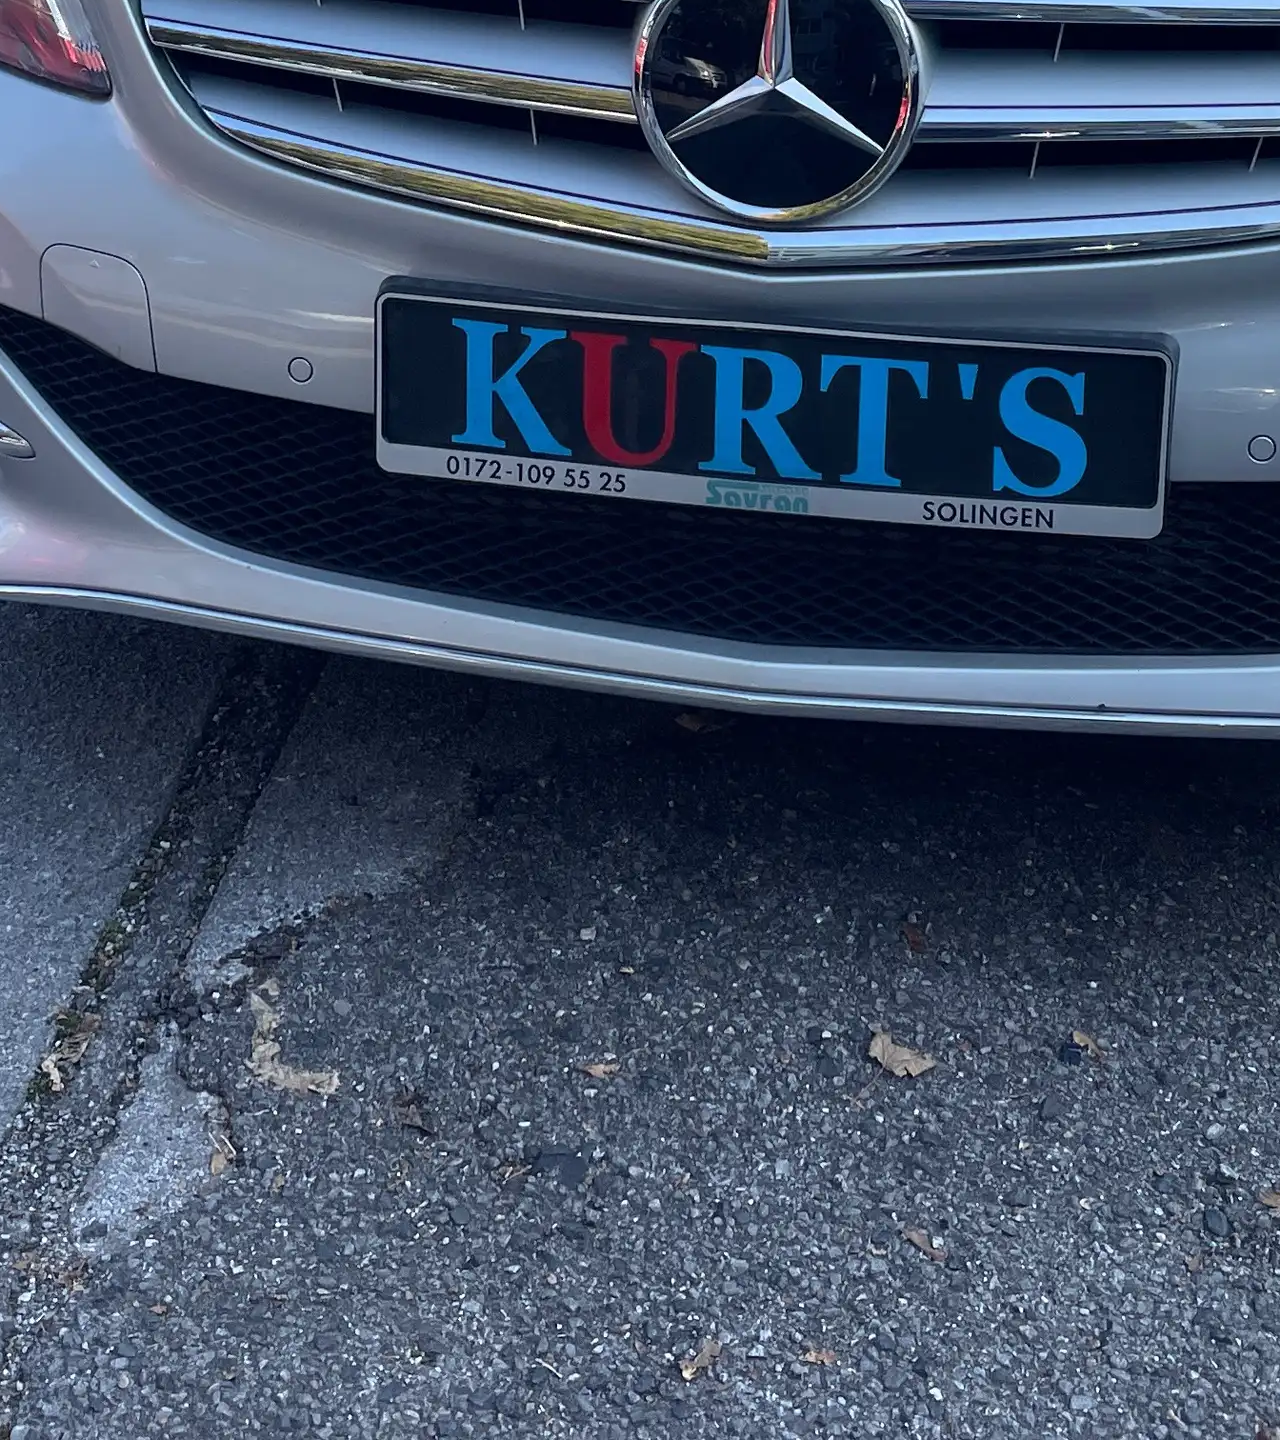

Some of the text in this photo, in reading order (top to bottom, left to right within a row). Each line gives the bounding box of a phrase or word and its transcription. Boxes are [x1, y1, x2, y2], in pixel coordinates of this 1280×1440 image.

[451, 317, 1088, 497] KURT'S
[446, 455, 626, 493] 0172-109 55 25
[705, 479, 809, 514] Savran
[922, 501, 1054, 529] SOLINGEN
